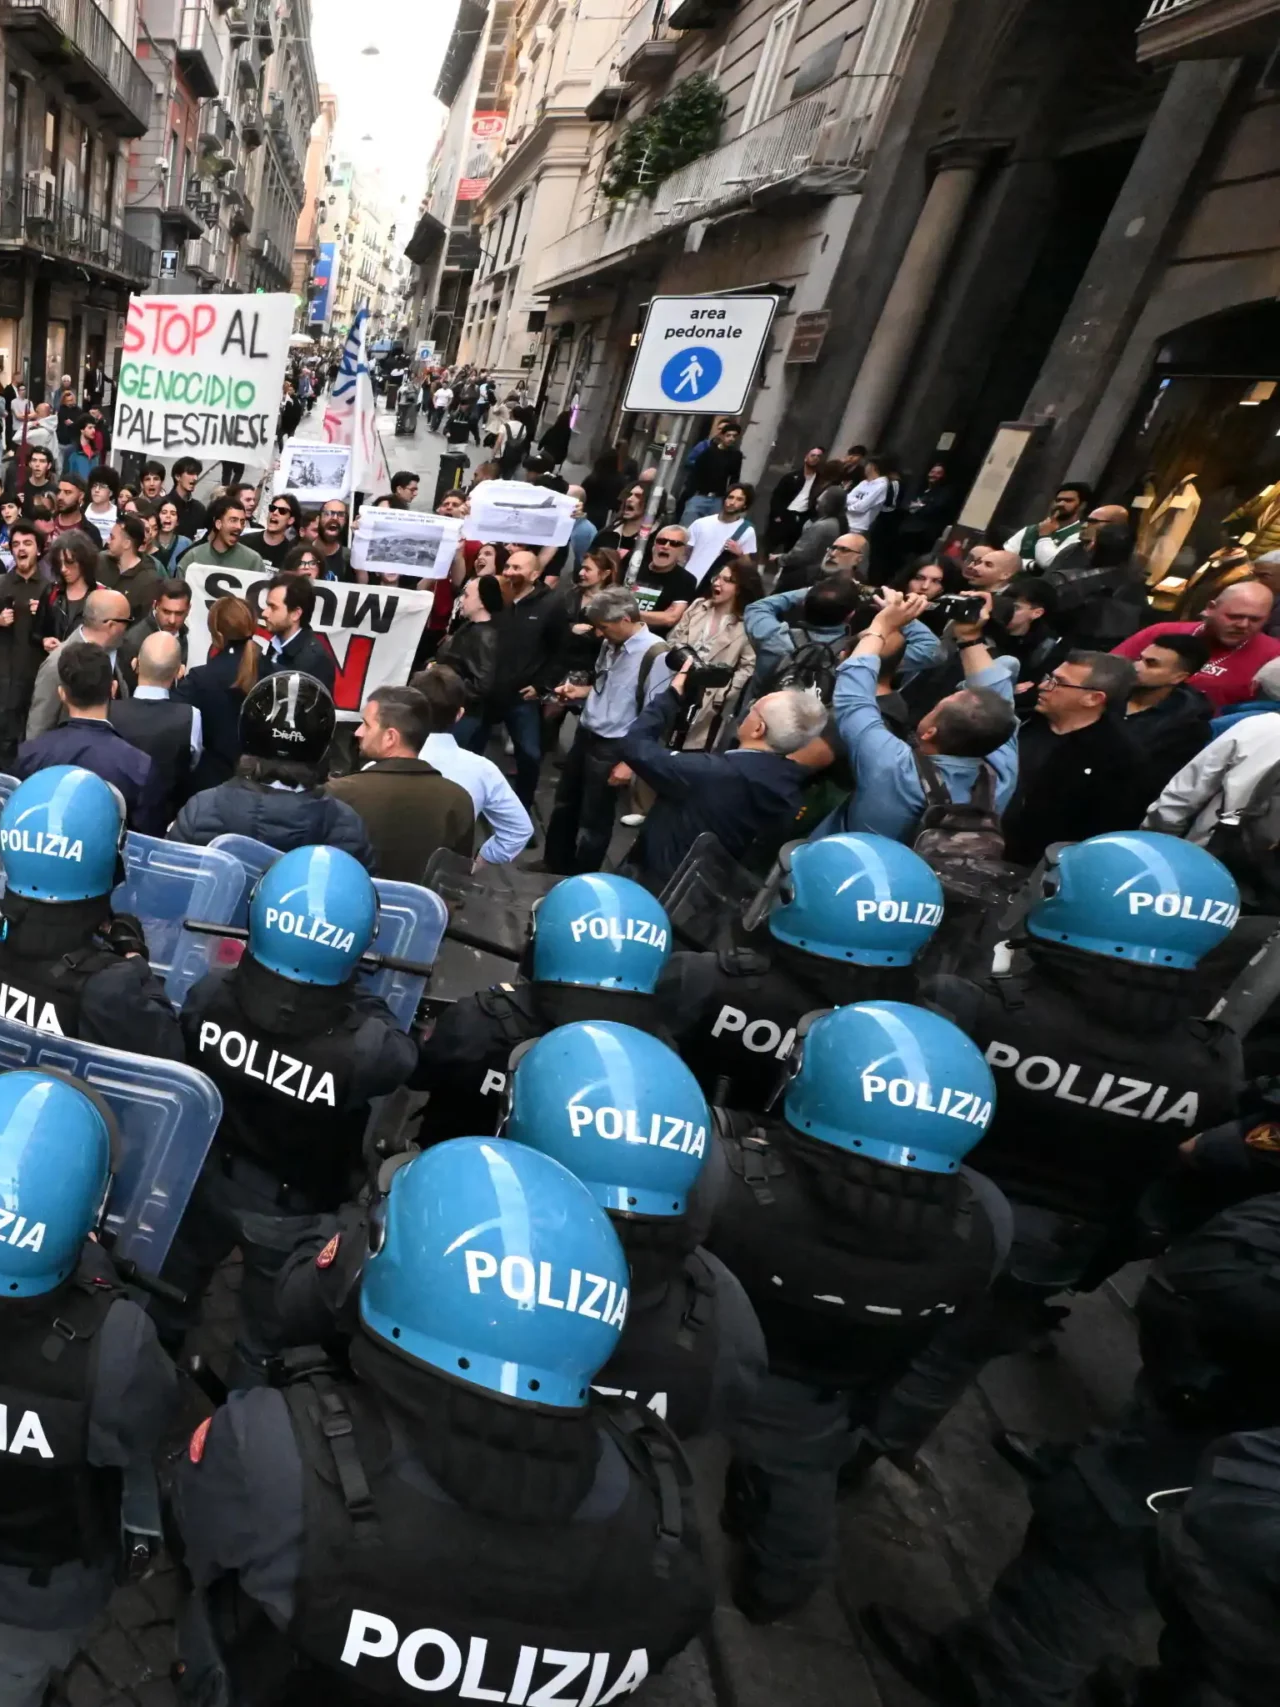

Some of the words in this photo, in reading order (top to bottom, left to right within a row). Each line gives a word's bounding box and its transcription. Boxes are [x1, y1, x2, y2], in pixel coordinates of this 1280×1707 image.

[122, 302, 217, 357] STOP
[220, 308, 269, 359] AL
[664, 325, 743, 340] pedonale
[690, 308, 727, 320] area
[119, 362, 257, 411] GENOCIDIO
[272, 727, 306, 743] Dieffe
[0, 828, 84, 863] POLIZIA
[265, 907, 355, 954] POLIZIA
[570, 917, 667, 952] POLIZIA
[857, 899, 943, 928] POLIZIA
[1128, 891, 1240, 931] POLIZIA
[199, 1020, 336, 1107] POLIZIA
[985, 1040, 1201, 1128] POLIZIA
[862, 1073, 995, 1129] POLIZIA
[568, 1105, 707, 1160] POLIZIA
[464, 1250, 631, 1333] POLIZIA
[340, 1609, 650, 1707] POLIZIA
